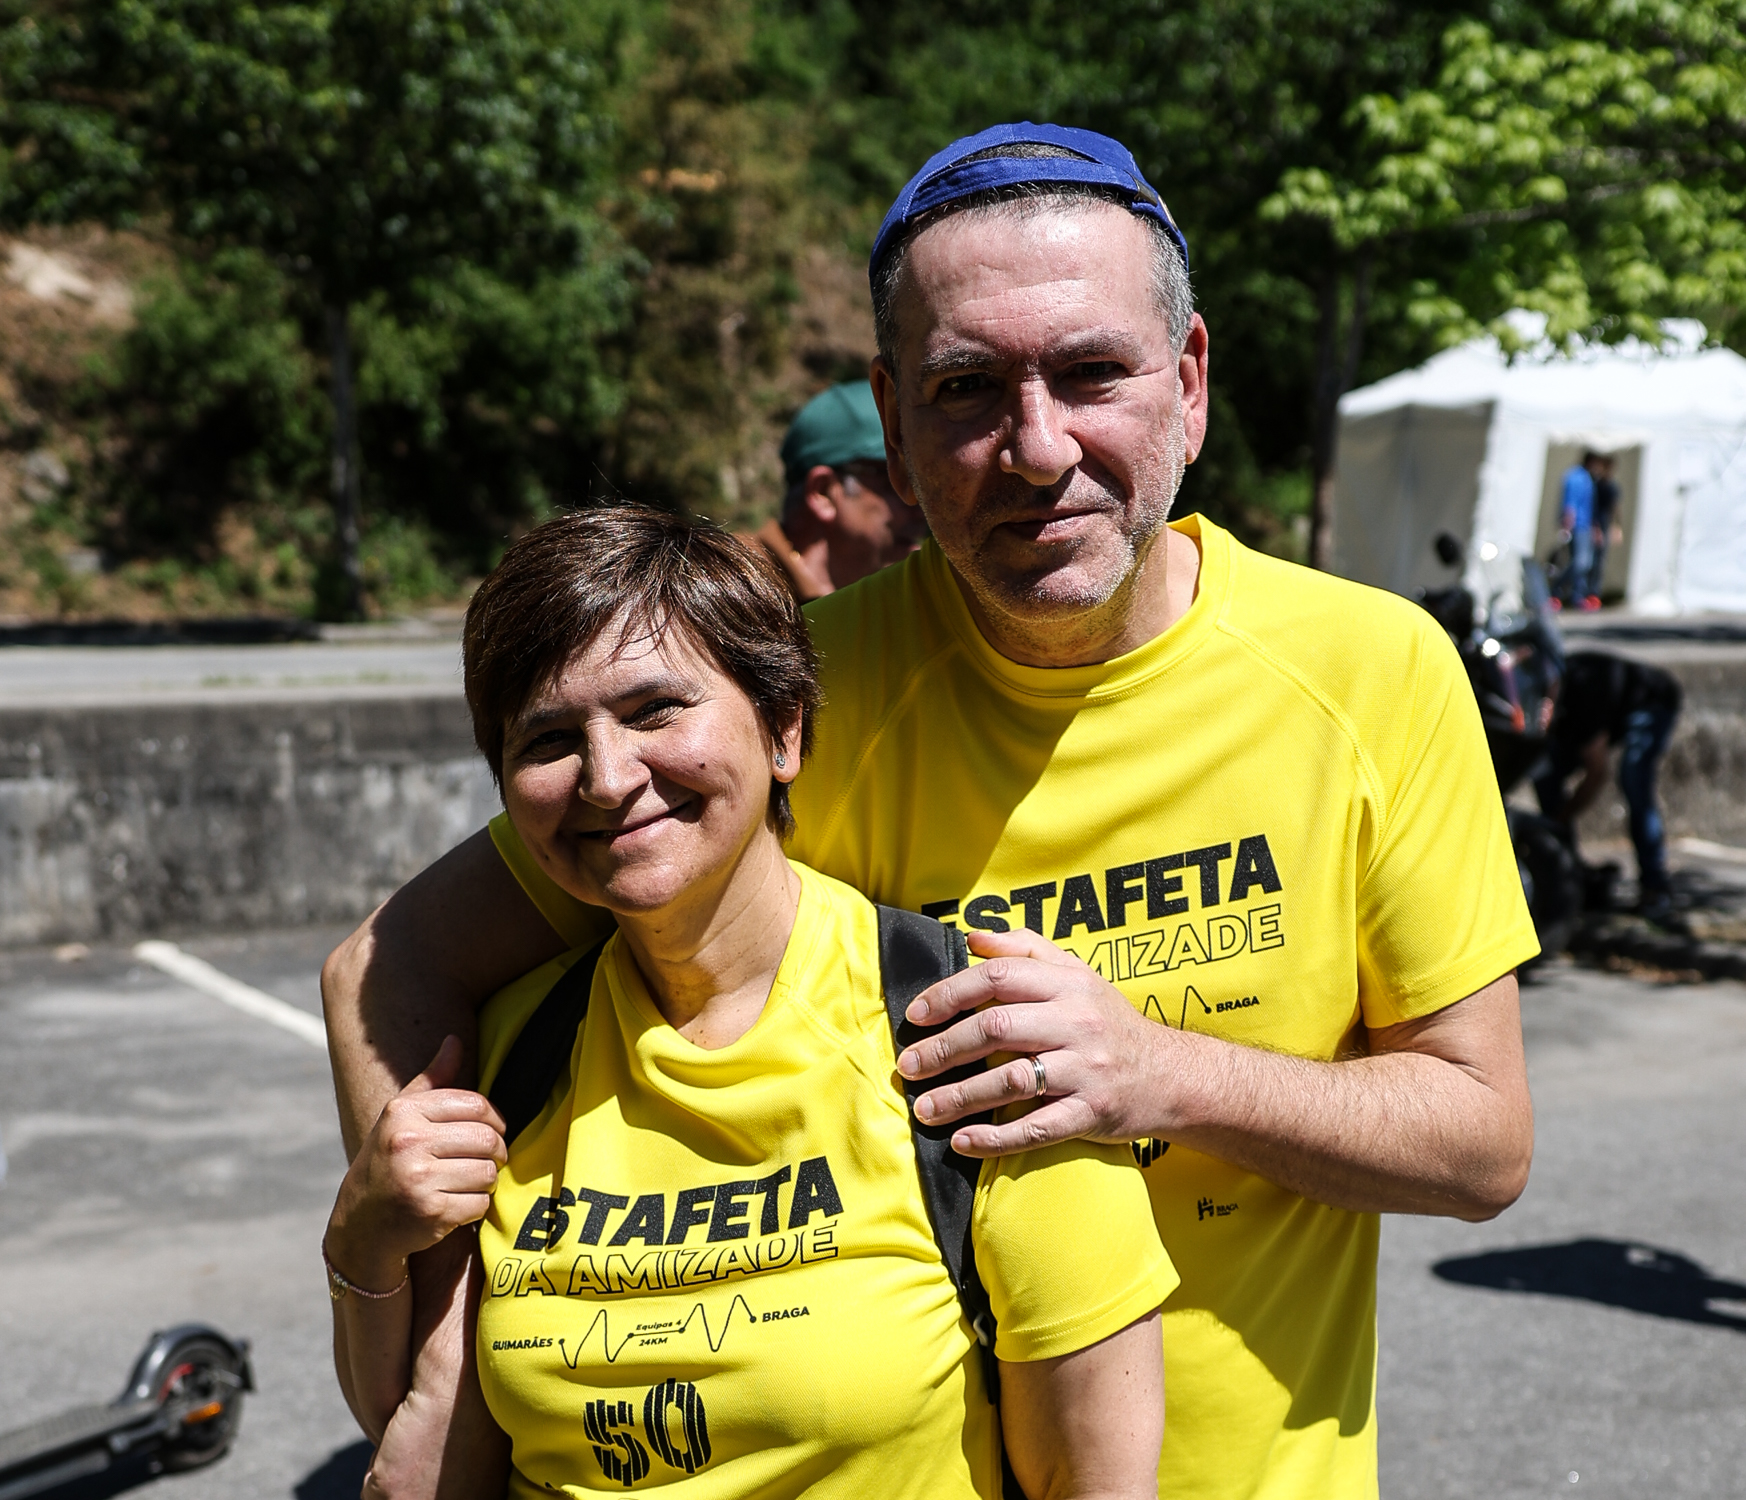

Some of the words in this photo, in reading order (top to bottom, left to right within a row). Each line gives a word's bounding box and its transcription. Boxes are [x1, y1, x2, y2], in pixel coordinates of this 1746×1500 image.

[1062, 903, 1285, 983] MIZADE
[1216, 995, 1260, 1013] BRAGA
[512, 1155, 844, 1253] ESTAFETA
[491, 1257, 557, 1298] DA
[566, 1219, 839, 1297] AMIZADE
[762, 1306, 810, 1323] BRAGA
[636, 1321, 673, 1331] Equipas
[492, 1336, 554, 1351] GUIMARÃES
[638, 1337, 668, 1347] 24KM
[583, 1377, 713, 1488] 50
